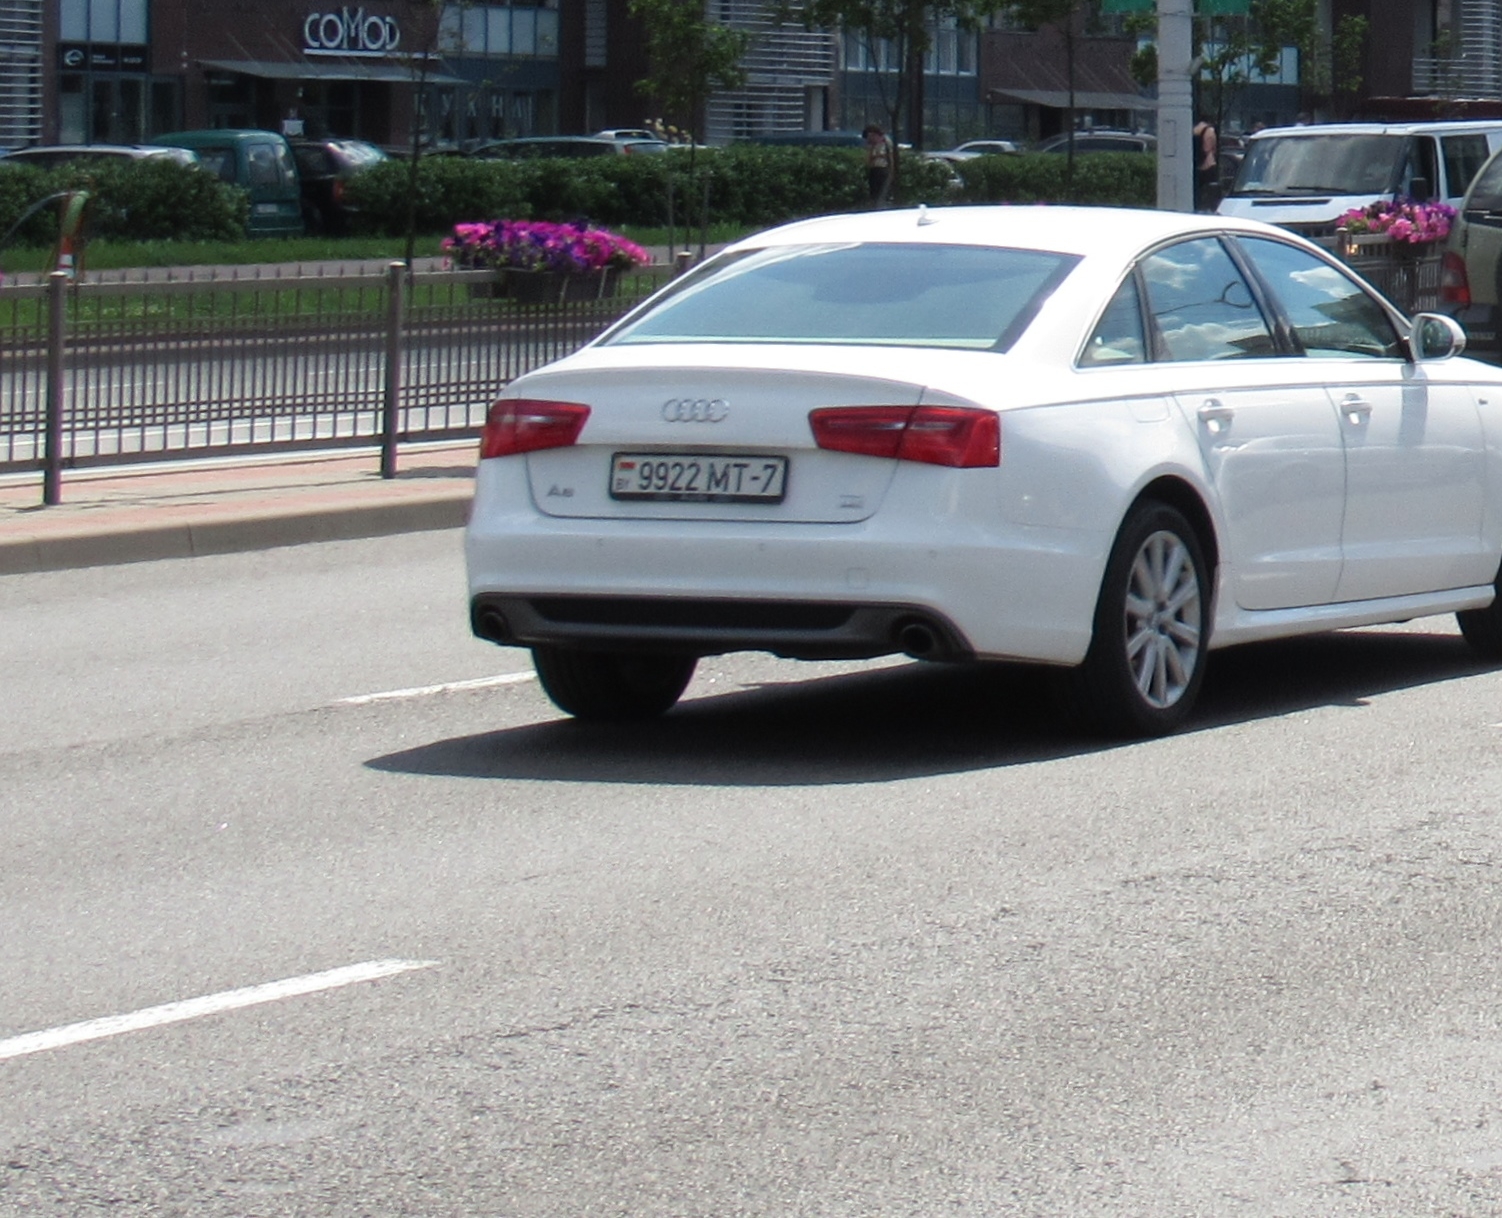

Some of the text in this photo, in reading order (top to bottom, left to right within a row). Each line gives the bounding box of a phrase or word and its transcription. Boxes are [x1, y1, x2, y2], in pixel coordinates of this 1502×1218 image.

[304, 5, 401, 51] COMOD
[638, 461, 778, 494] 9922 MT-7
